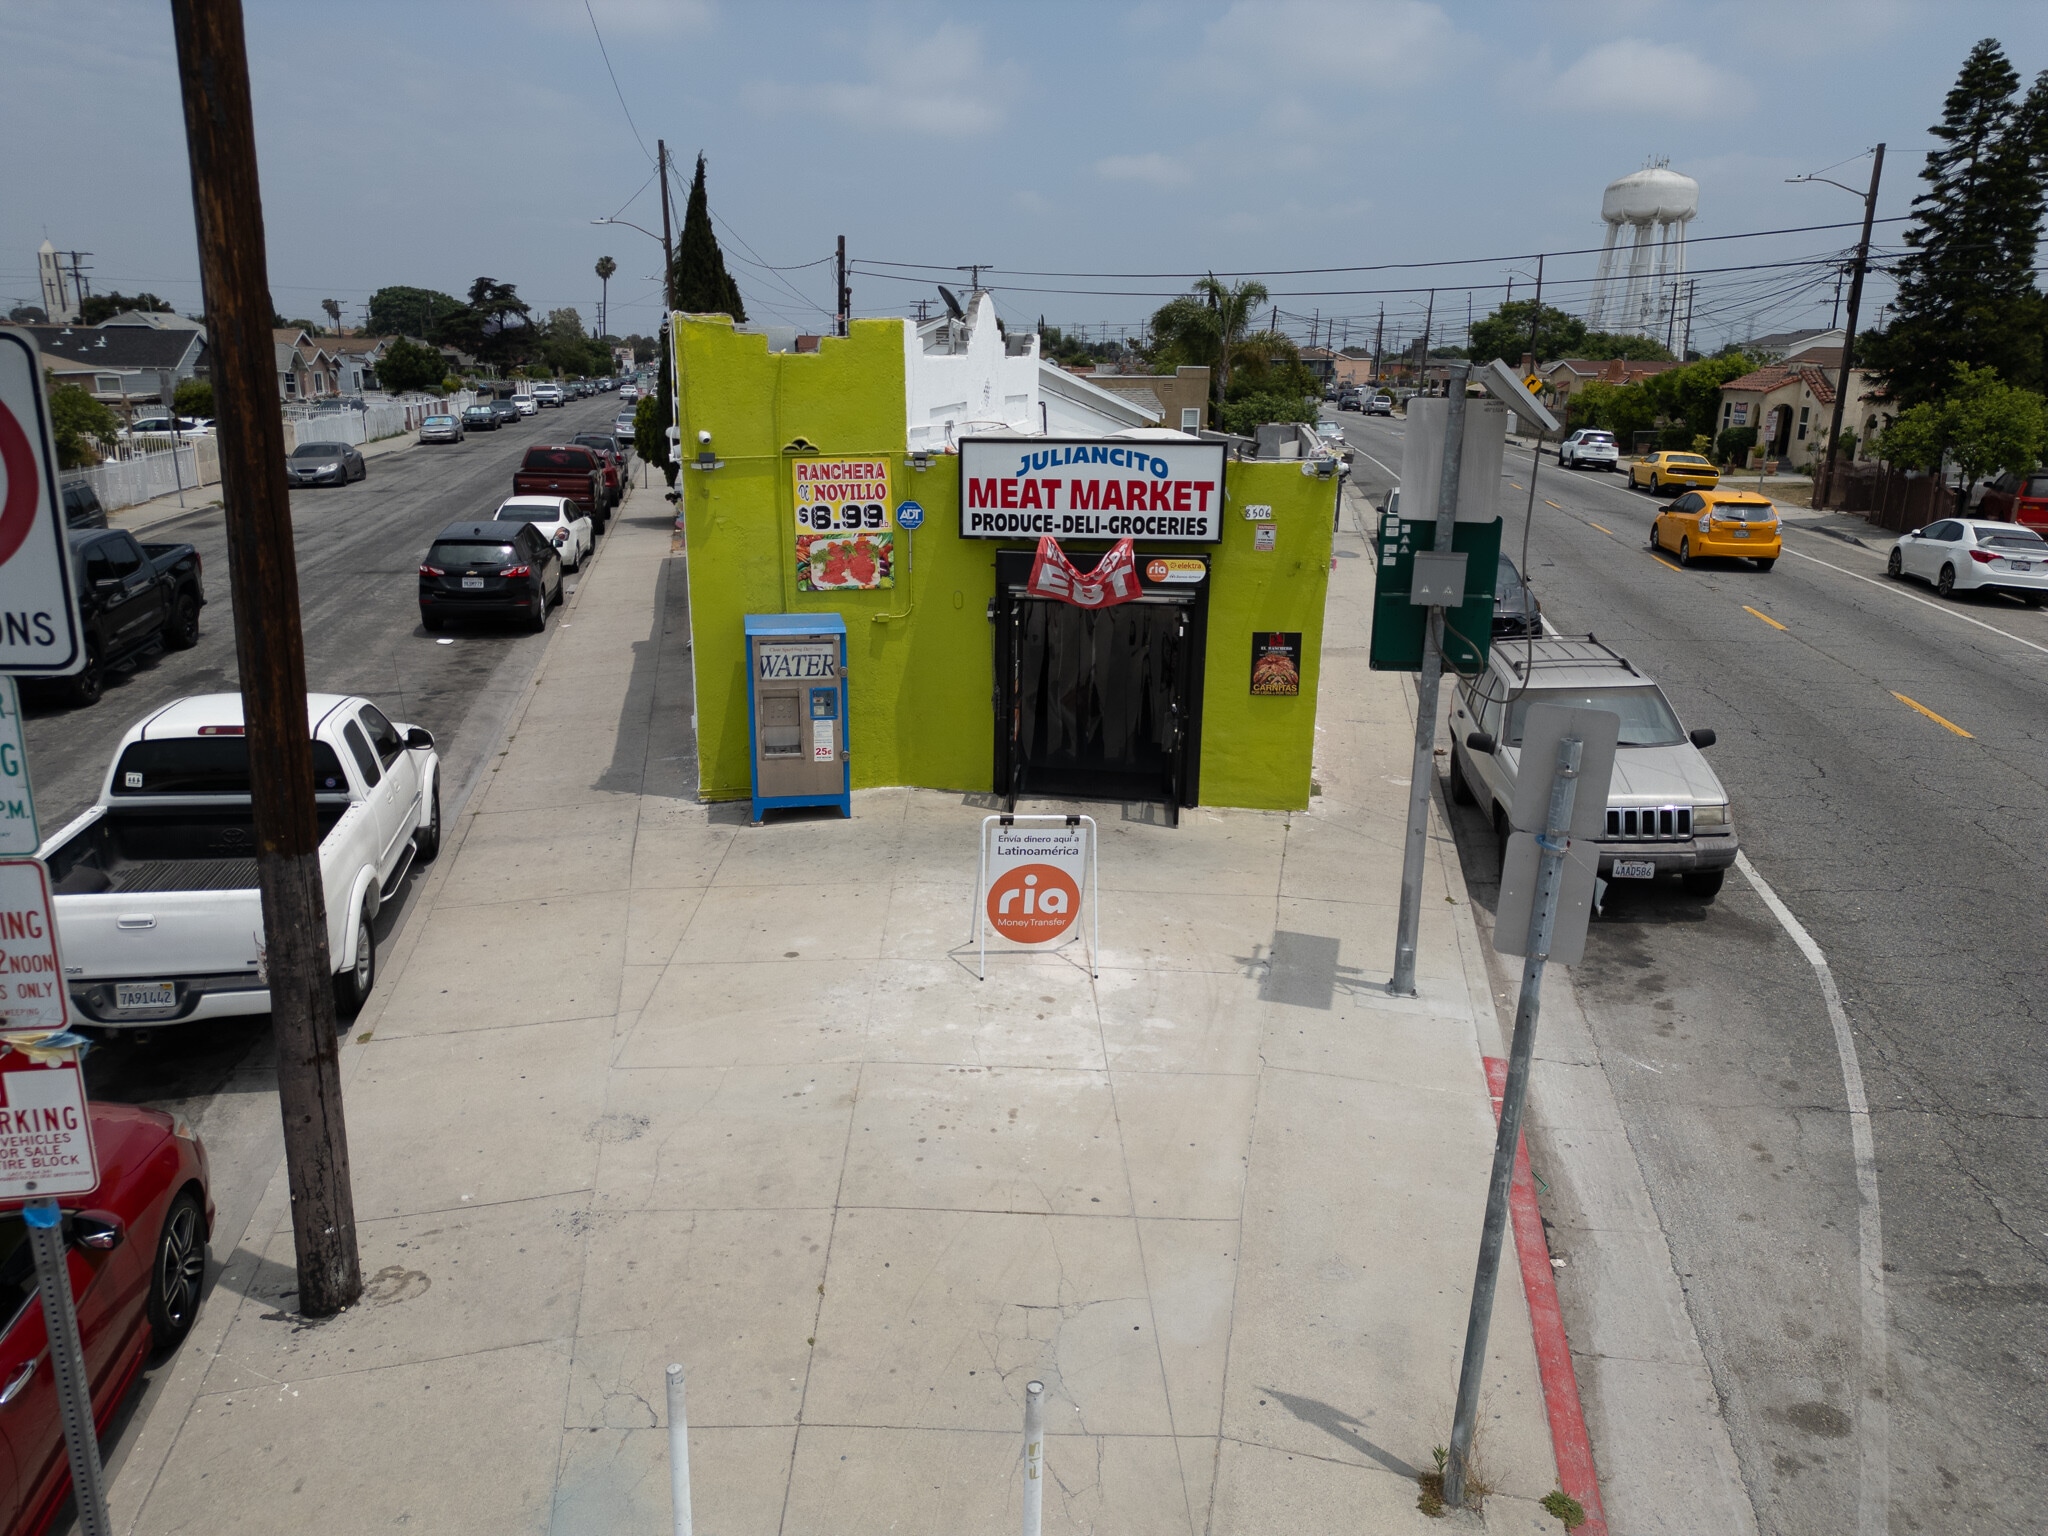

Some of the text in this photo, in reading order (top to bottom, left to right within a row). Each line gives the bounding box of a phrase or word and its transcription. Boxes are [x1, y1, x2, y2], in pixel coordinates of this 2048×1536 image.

[1016, 446, 1169, 479] JULIANCITO
[796, 463, 885, 480] RANCHERA
[814, 483, 886, 501] NOVILLO
[968, 477, 1215, 512] MEAT MARKET
[899, 508, 921, 520] ADT
[1245, 507, 1271, 519] 8506
[1149, 562, 1167, 574] ria
[1036, 562, 1133, 605] EBT
[760, 654, 834, 677] WATER
[998, 834, 1022, 843] Envía
[1023, 835, 1052, 843] dinero
[1053, 835, 1073, 844] aquí
[997, 845, 1079, 856] Latinoamérica
[998, 874, 1068, 914] ria
[997, 917, 1067, 928] Money Transfer
[17, 982, 53, 999] ONLY
[0, 1132, 72, 1148] VEHICLES
[25, 1144, 62, 1158] SALE
[32, 1154, 80, 1168] BLOCK
